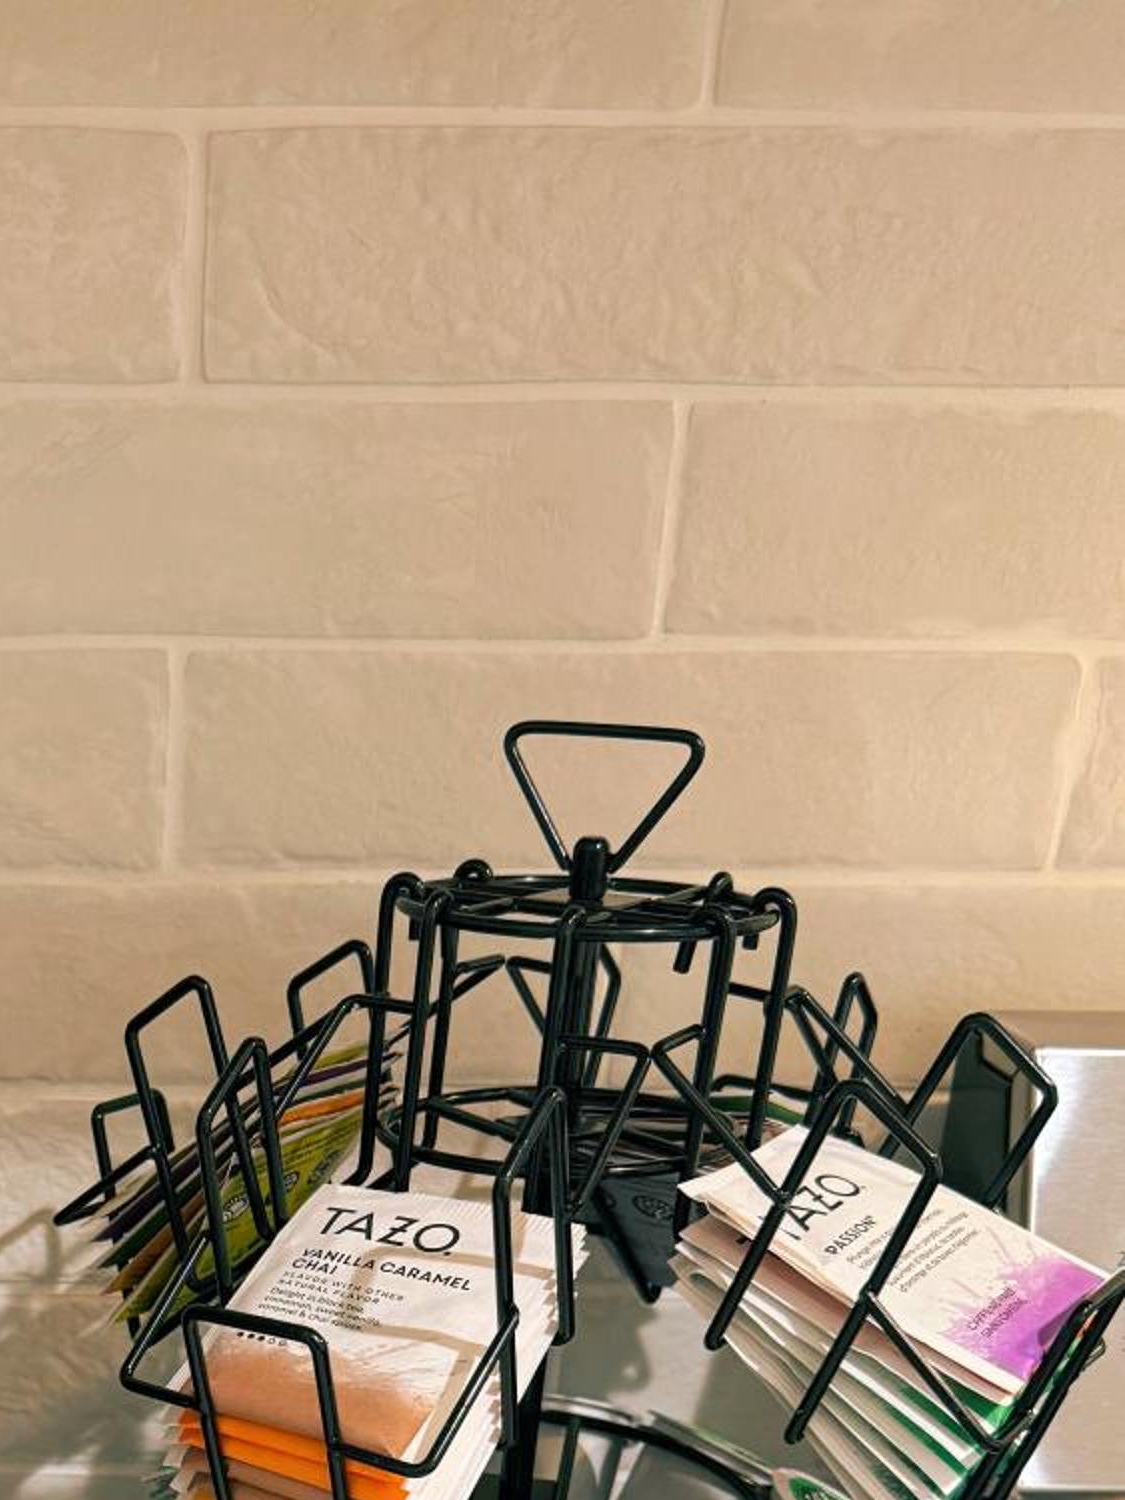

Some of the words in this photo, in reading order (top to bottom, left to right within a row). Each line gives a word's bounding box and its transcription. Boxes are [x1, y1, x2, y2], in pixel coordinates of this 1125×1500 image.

[291, 1258, 339, 1276] CHAI
[302, 1248, 376, 1271] VANILLA
[379, 1261, 474, 1291] CARAMEL
